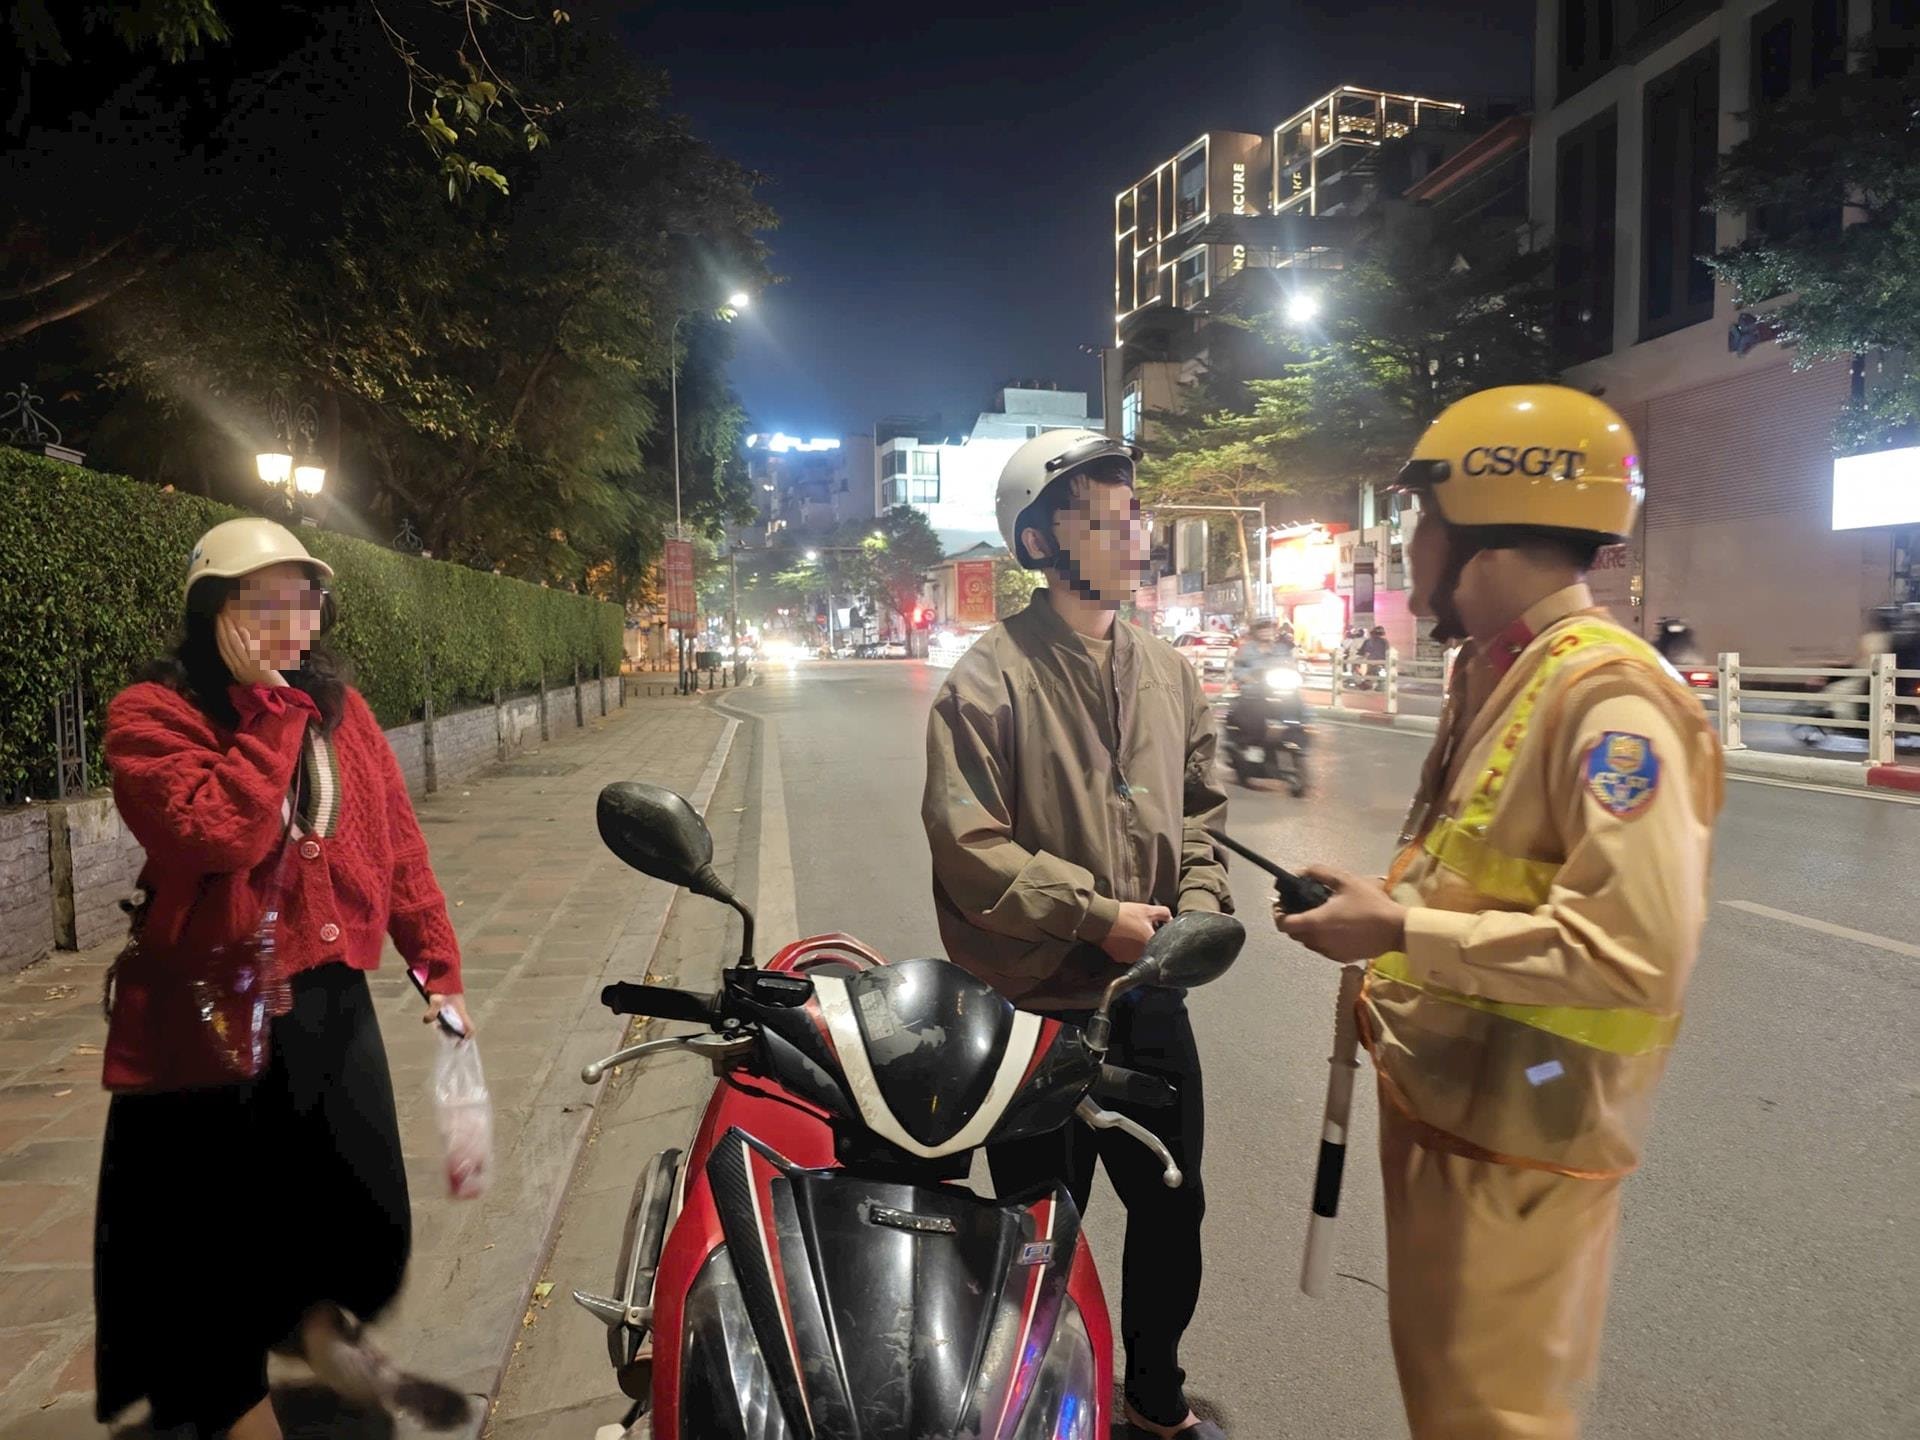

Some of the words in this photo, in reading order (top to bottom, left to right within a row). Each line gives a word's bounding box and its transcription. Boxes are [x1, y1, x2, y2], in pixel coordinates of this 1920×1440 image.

[1233, 163, 1245, 215] RCURE
[1463, 446, 1586, 480] CSGT
[1024, 1244, 1051, 1258] FI
